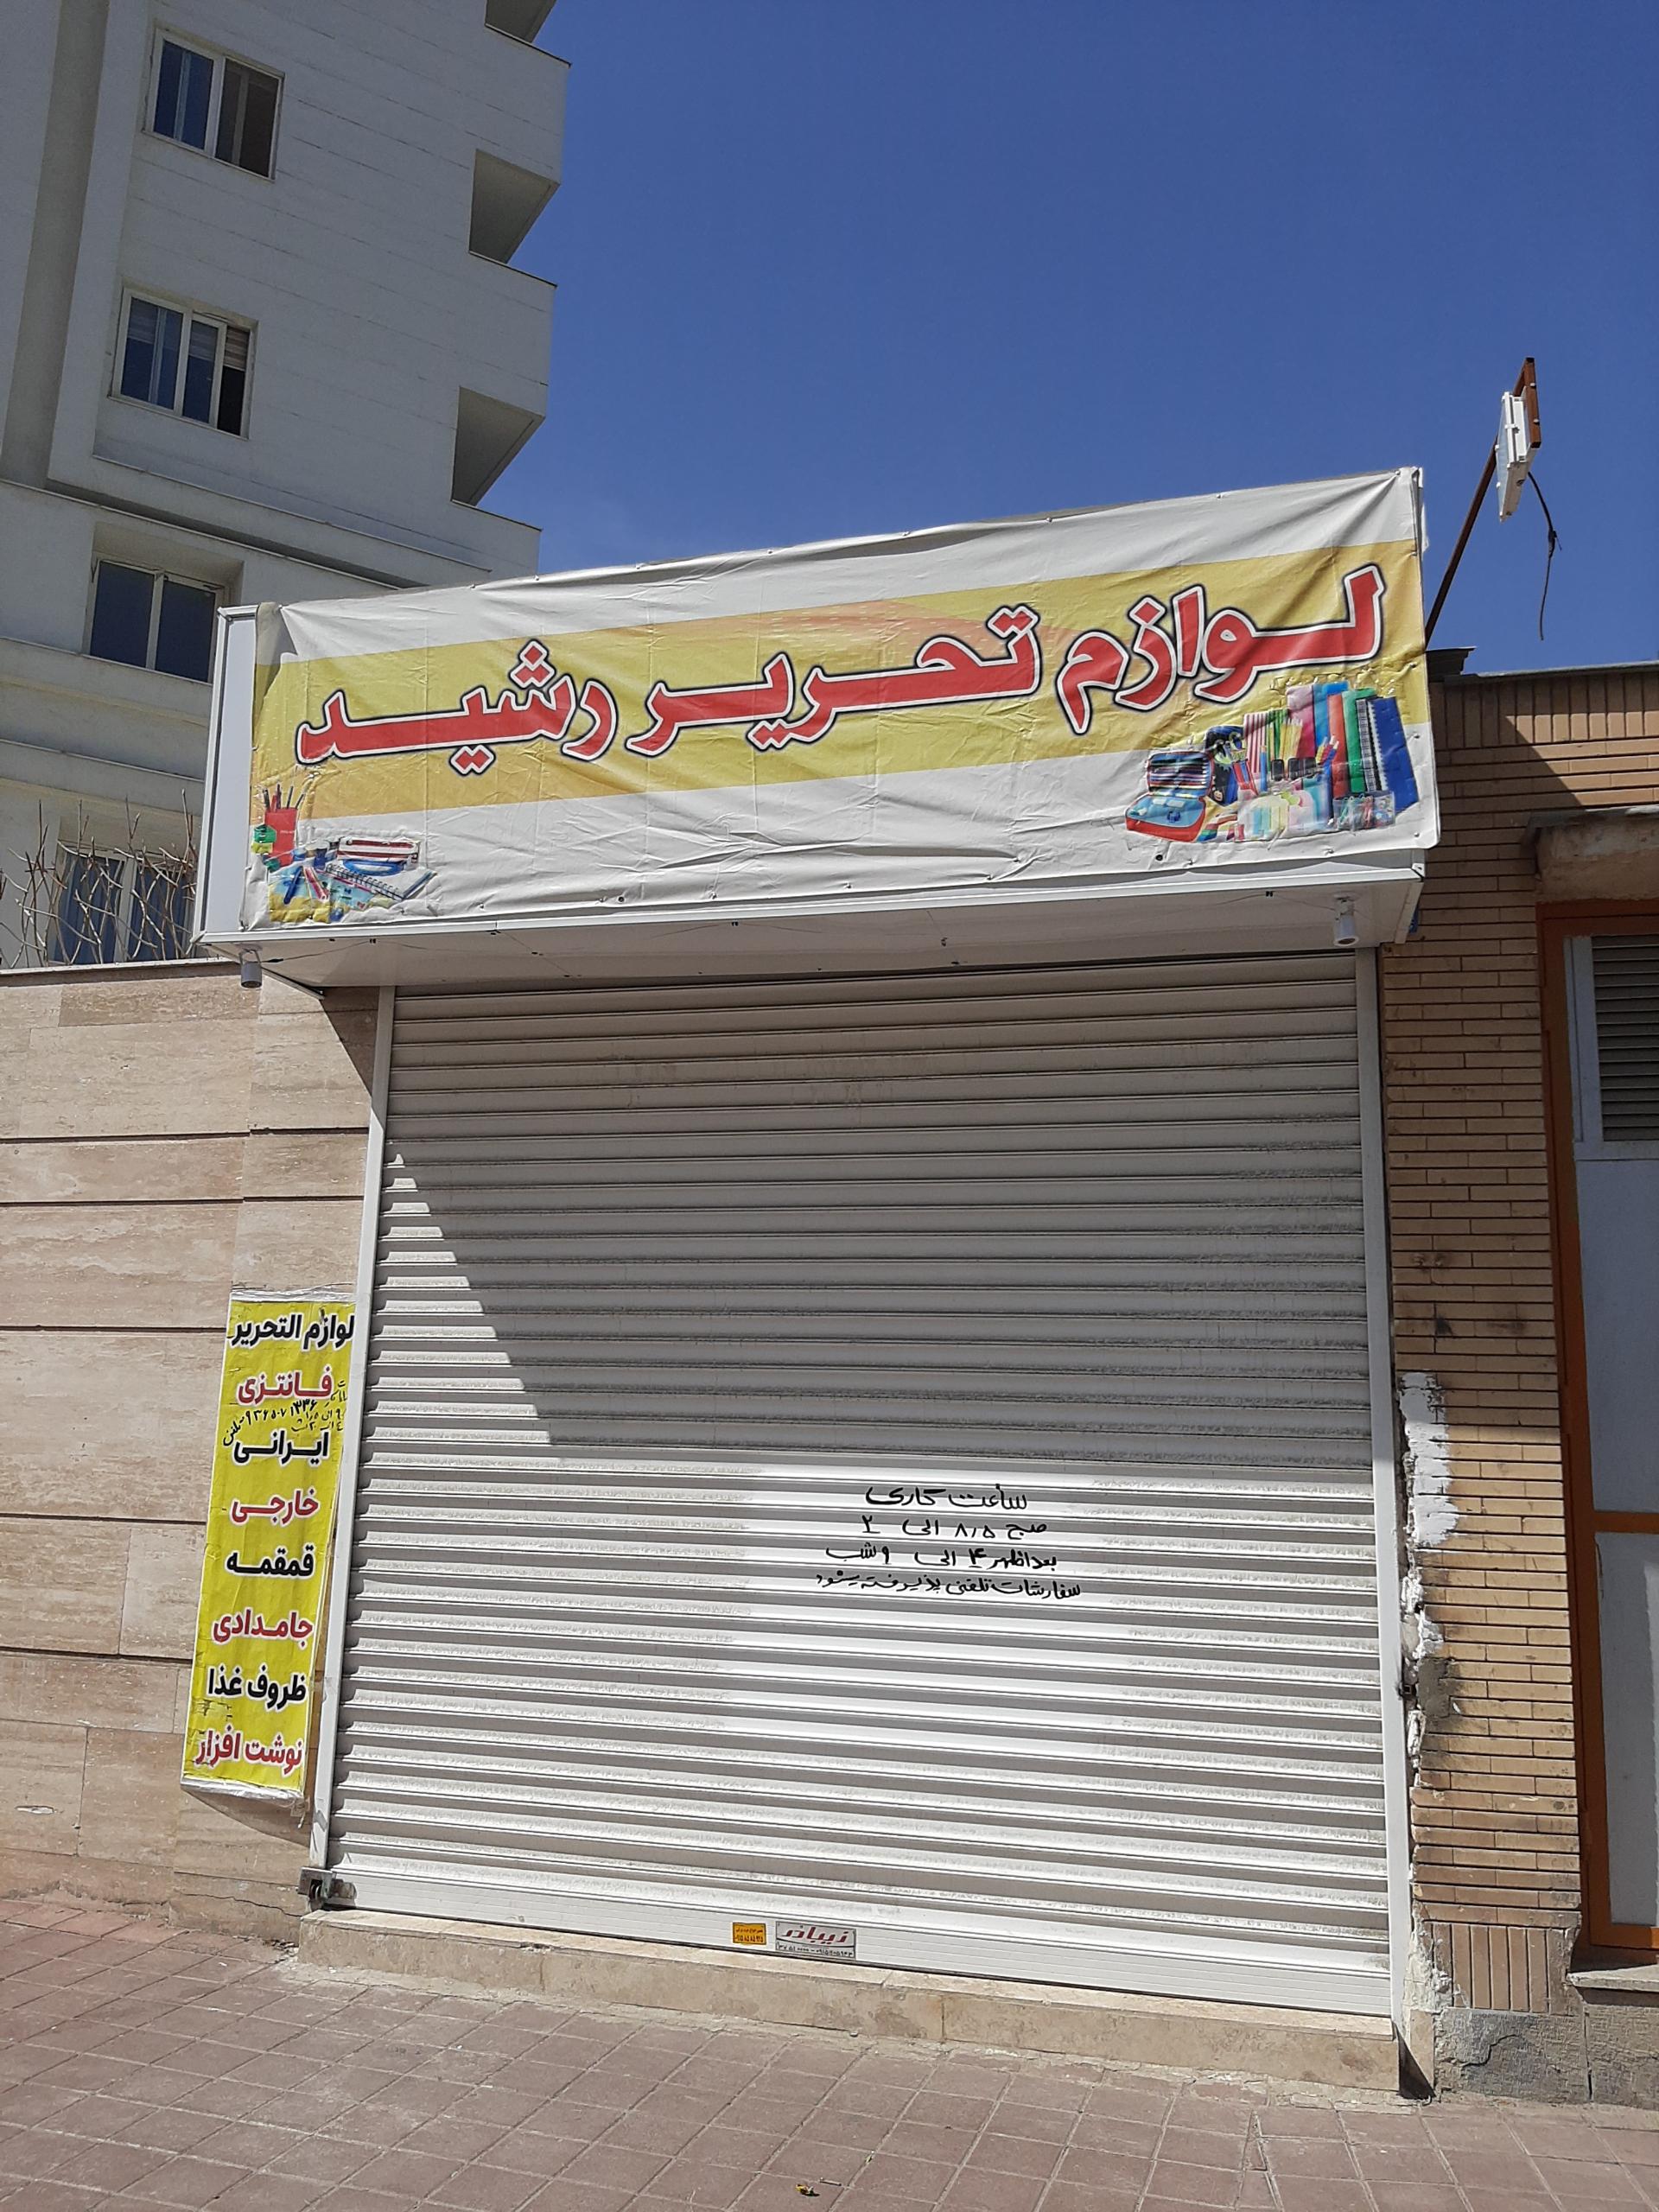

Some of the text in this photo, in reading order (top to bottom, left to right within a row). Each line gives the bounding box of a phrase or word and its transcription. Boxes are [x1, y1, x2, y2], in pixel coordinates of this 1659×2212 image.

[296, 563, 1384, 776] لوازم تحریر رشید
[230, 1314, 354, 1350] لوازم التحریر
[238, 1366, 333, 1404] فانتزی
[233, 1430, 329, 1465] ایرانی
[232, 1489, 319, 1524] خارجی
[866, 1486, 947, 1506] کاری
[902, 1518, 939, 1535] الی
[226, 1544, 315, 1577] قمقمه
[826, 1541, 877, 1562] شب
[914, 1549, 957, 1567] الی
[213, 1608, 314, 1648] جامدادی
[207, 1664, 307, 1709] ظروف غذا
[195, 1725, 303, 1775] نوشت افزار
